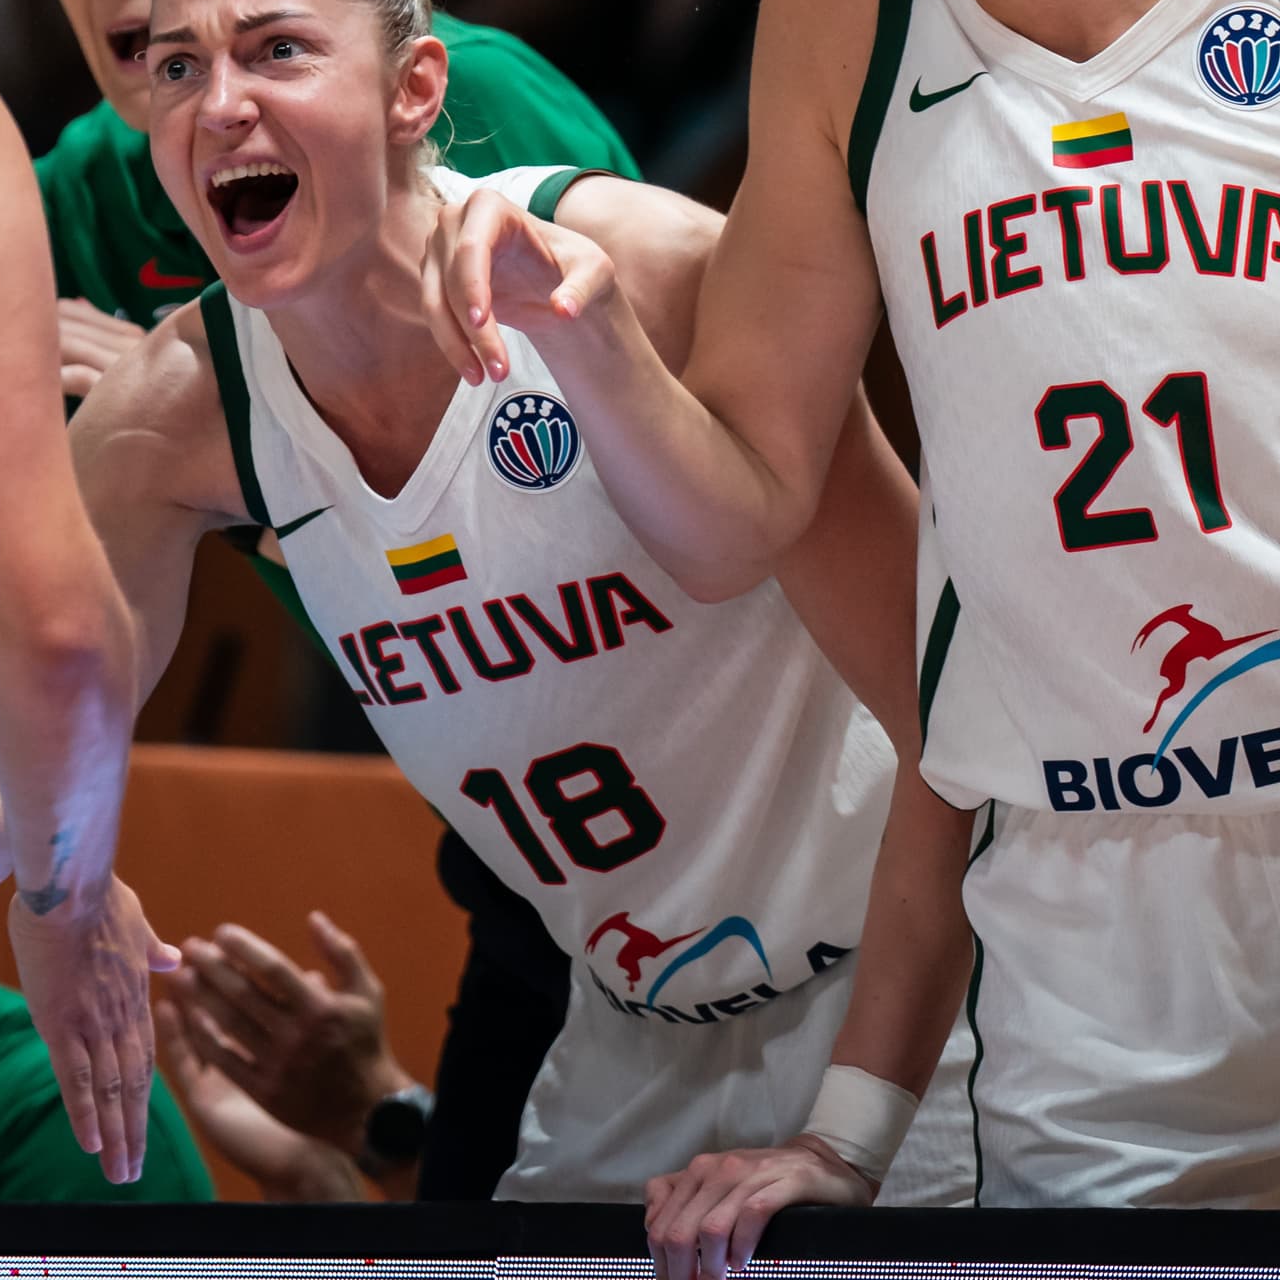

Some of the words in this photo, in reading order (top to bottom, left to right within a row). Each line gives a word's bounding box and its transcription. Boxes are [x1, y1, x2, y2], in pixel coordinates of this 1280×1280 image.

[1213, 13, 1280, 42] 2025
[496, 397, 554, 433] 2025
[1034, 371, 1232, 552] 21
[460, 743, 666, 885] 18
